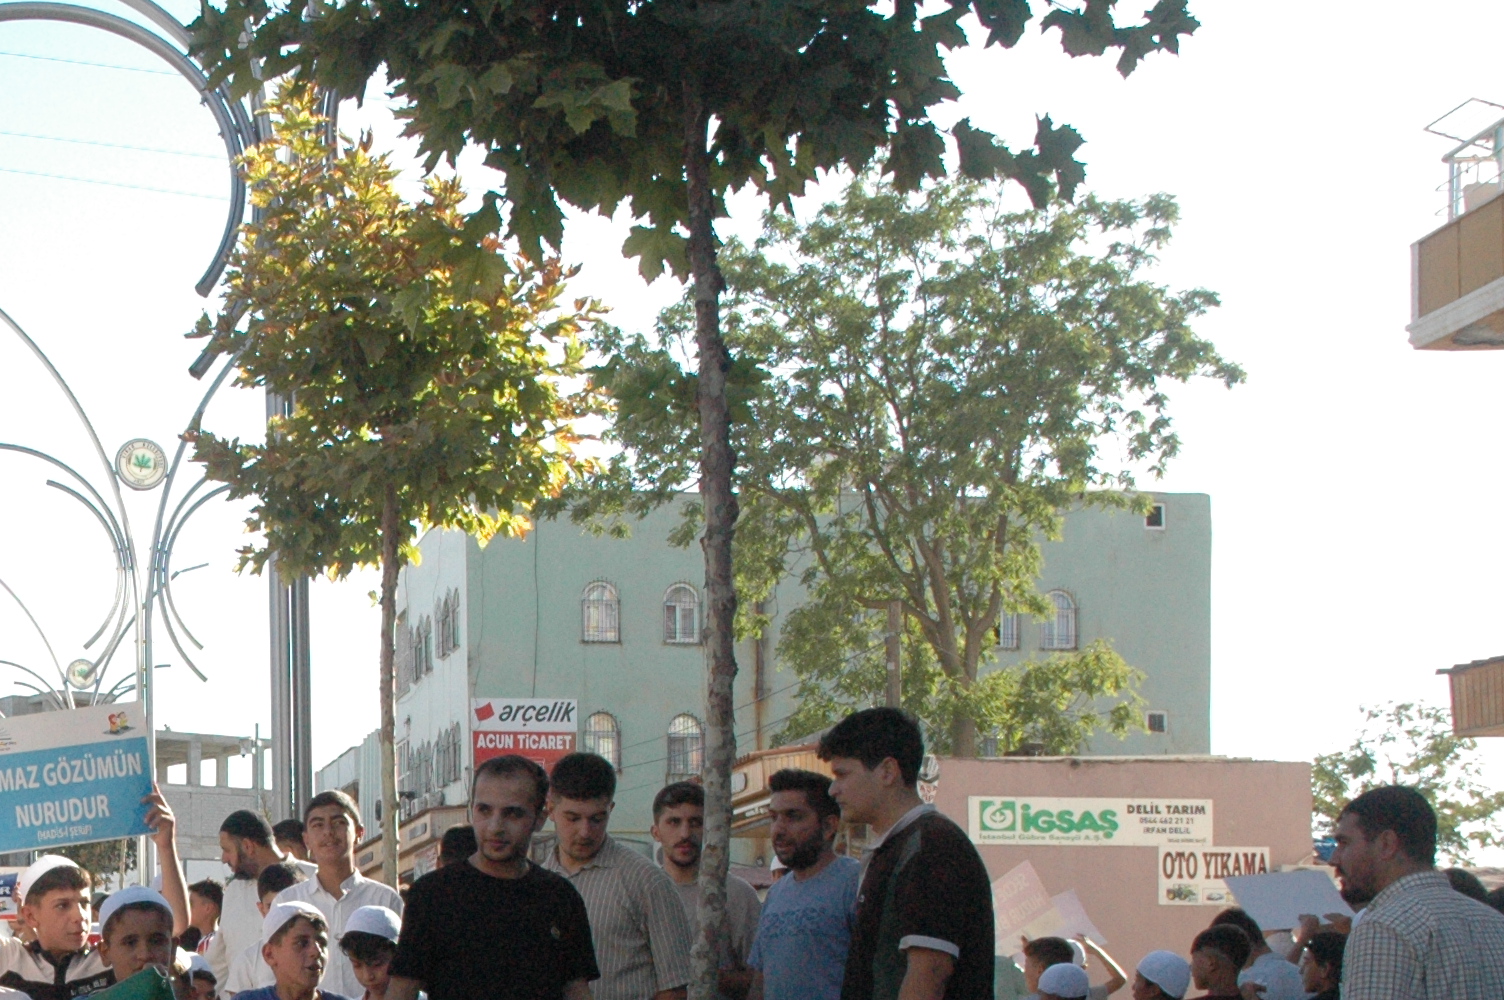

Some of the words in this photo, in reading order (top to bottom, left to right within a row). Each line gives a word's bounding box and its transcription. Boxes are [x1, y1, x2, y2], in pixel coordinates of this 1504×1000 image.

[498, 701, 576, 727] arçelik
[476, 733, 514, 749] ACUN
[517, 733, 573, 750] TİCARET
[43, 750, 143, 787] GÖZÜMÜN
[15, 795, 111, 829] NURUDUR
[1021, 803, 1119, 839] İGSAŞ
[1127, 802, 1162, 814] DELİL
[1165, 804, 1206, 815] TARIM
[1162, 851, 1198, 879] OTO
[1202, 852, 1267, 879] YIKAMA
